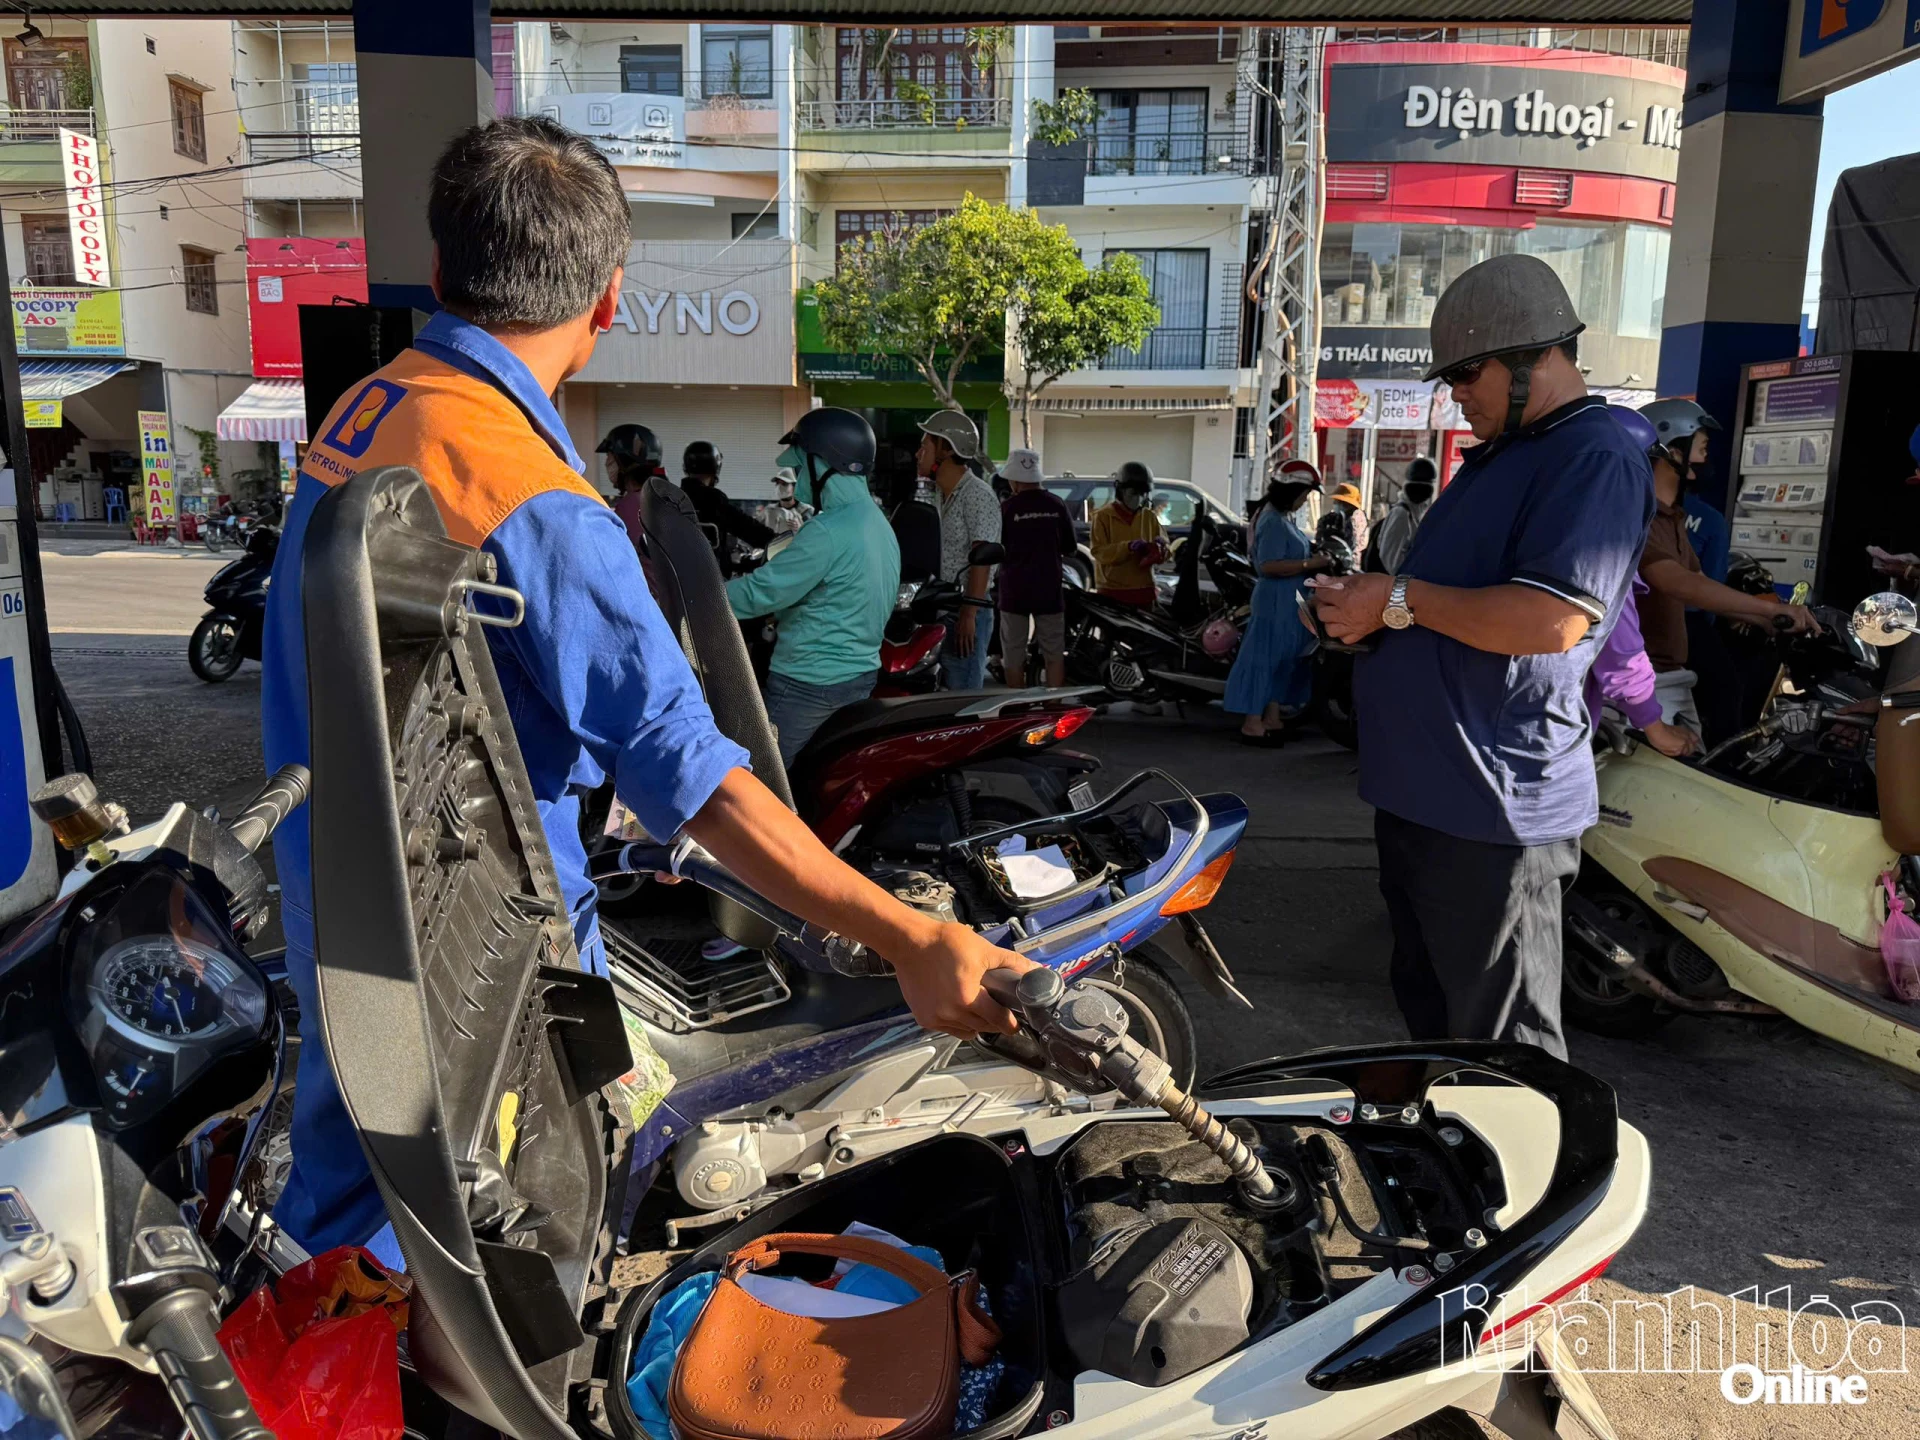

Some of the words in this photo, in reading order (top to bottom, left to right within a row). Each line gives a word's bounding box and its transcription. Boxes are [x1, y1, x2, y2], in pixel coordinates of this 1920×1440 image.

[1404, 85, 1503, 140] Điện
[1513, 90, 1615, 147] thoại
[69, 134, 102, 282] PHOTOCOPY
[11, 301, 79, 313] OCOPY
[1336, 343, 1378, 362] THÁI
[1382, 406, 1405, 418] ote
[144, 432, 168, 452] in
[1803, 558, 1816, 570] 02
[3, 592, 23, 614] 06
[915, 725, 986, 742] VISION
